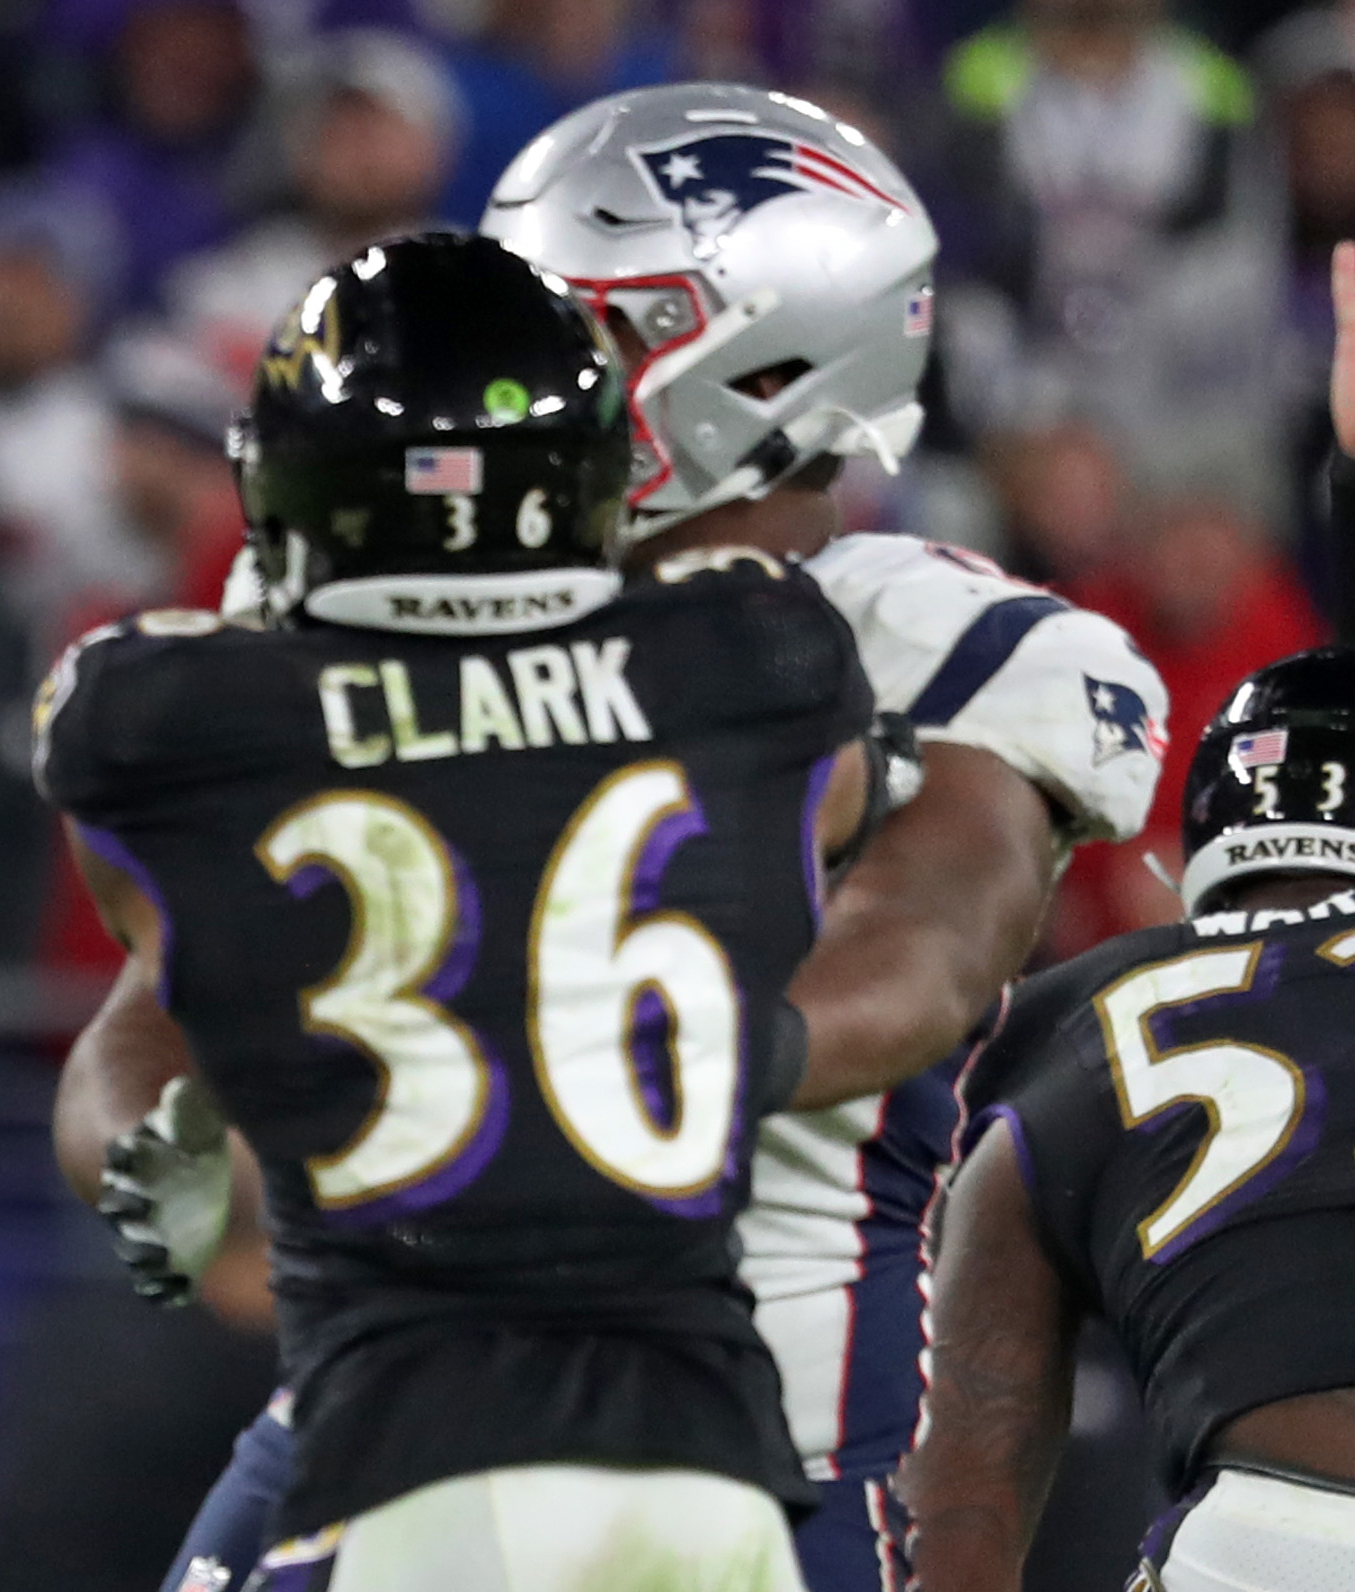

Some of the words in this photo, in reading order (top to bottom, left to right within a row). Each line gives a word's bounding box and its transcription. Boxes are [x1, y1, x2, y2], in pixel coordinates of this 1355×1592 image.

[389, 588, 575, 620] RAVENS
[318, 636, 653, 770] CLARK
[254, 758, 745, 1222] 36
